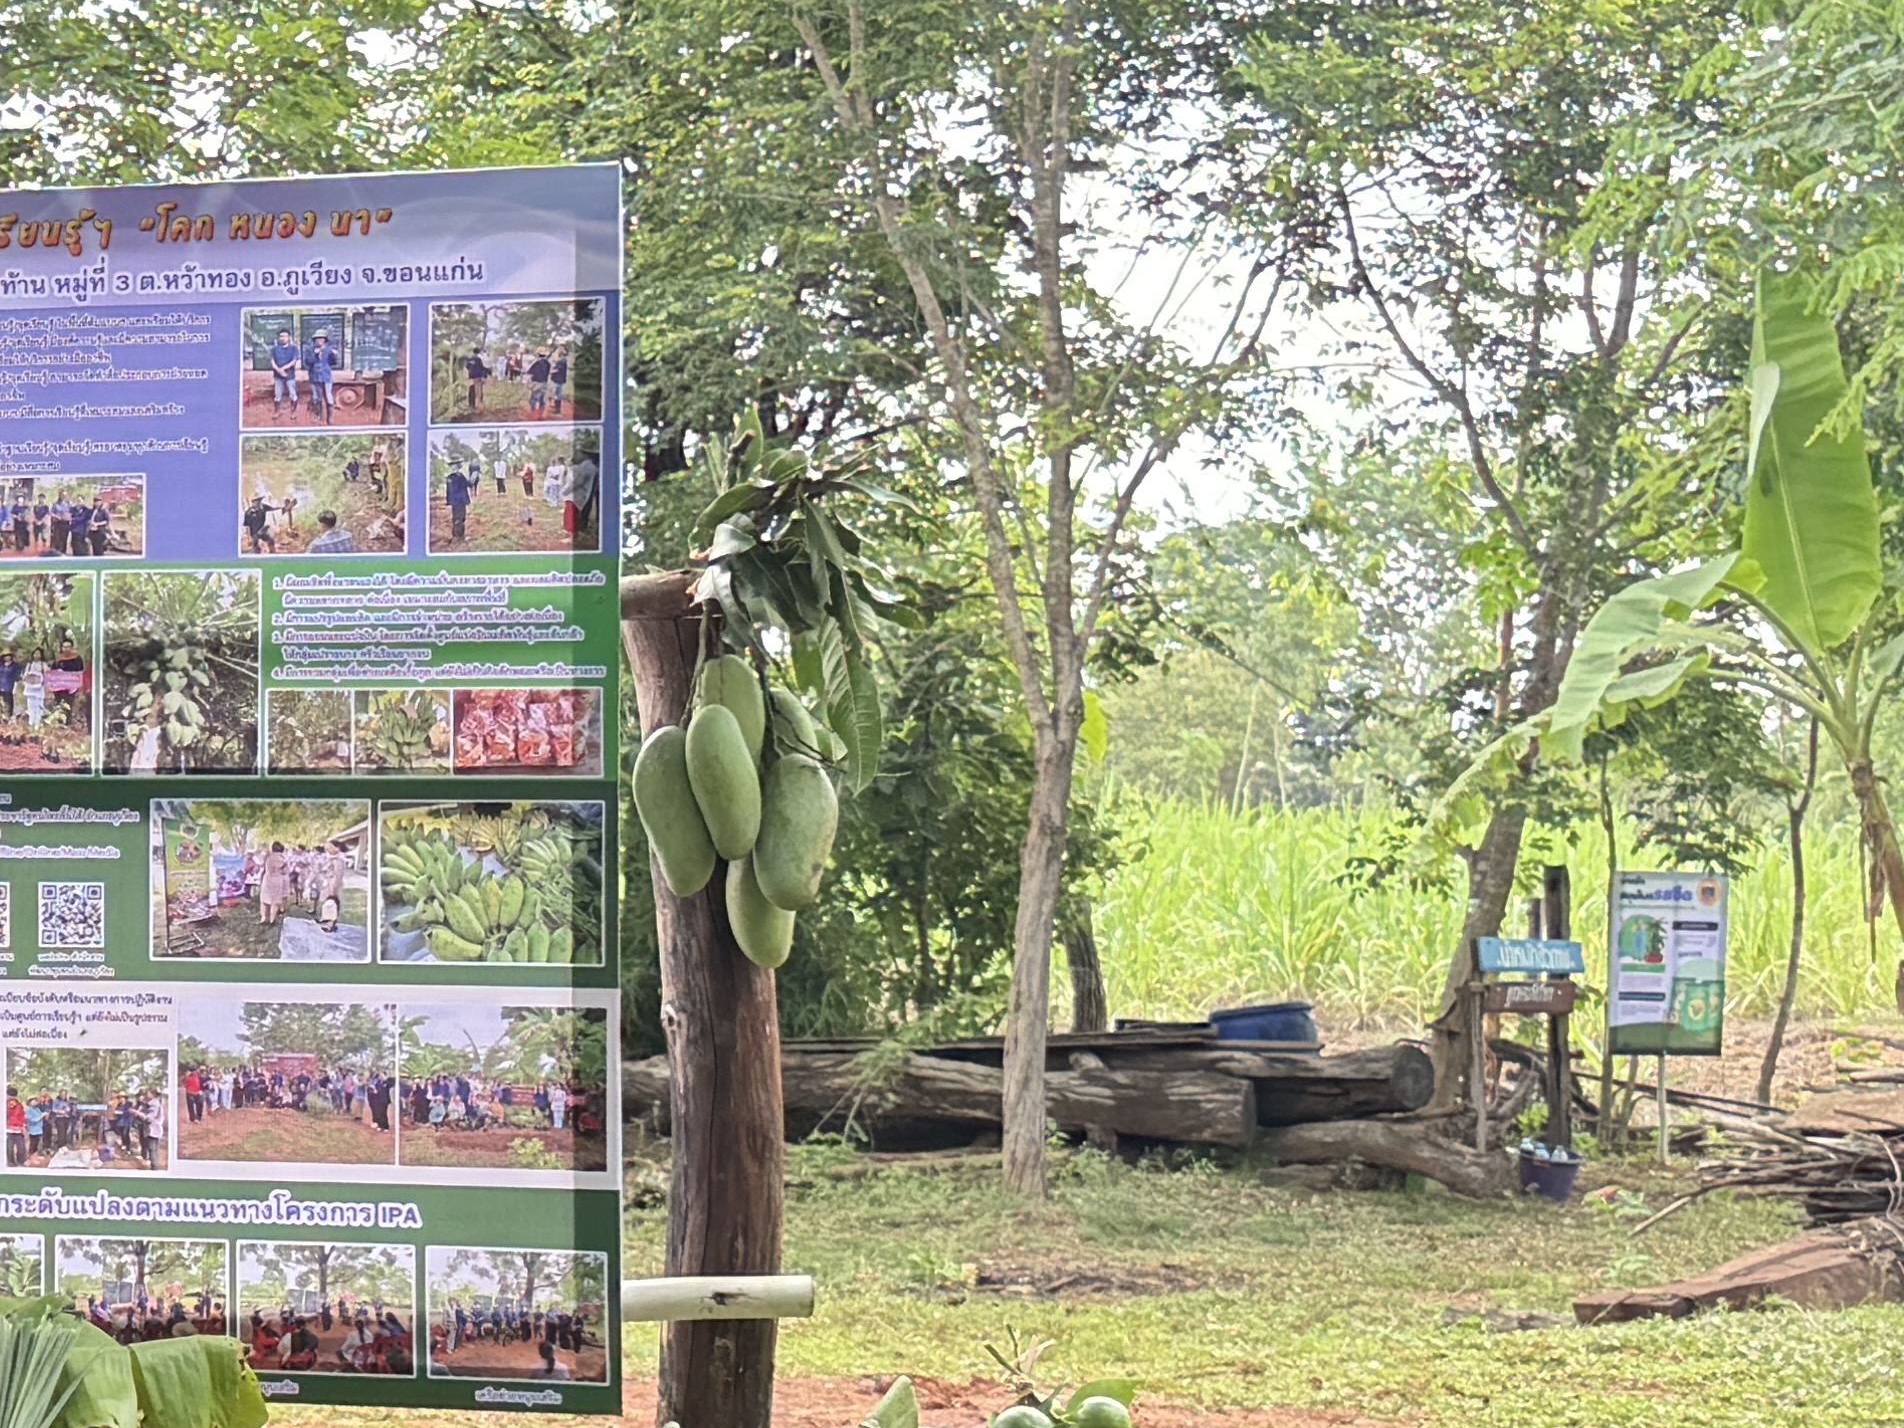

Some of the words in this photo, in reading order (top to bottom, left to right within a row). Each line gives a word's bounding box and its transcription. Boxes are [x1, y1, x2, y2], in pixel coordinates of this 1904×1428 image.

[228, 208, 317, 241] หนอง
[54, 256, 107, 303] หมู่ที่
[114, 275, 131, 293] 3
[138, 261, 253, 292] ต.หว้าทอง
[260, 258, 353, 296] อ.ภูเวียง
[360, 255, 485, 286] จ.ขอนแก่น
[376, 1201, 422, 1229] IPA
